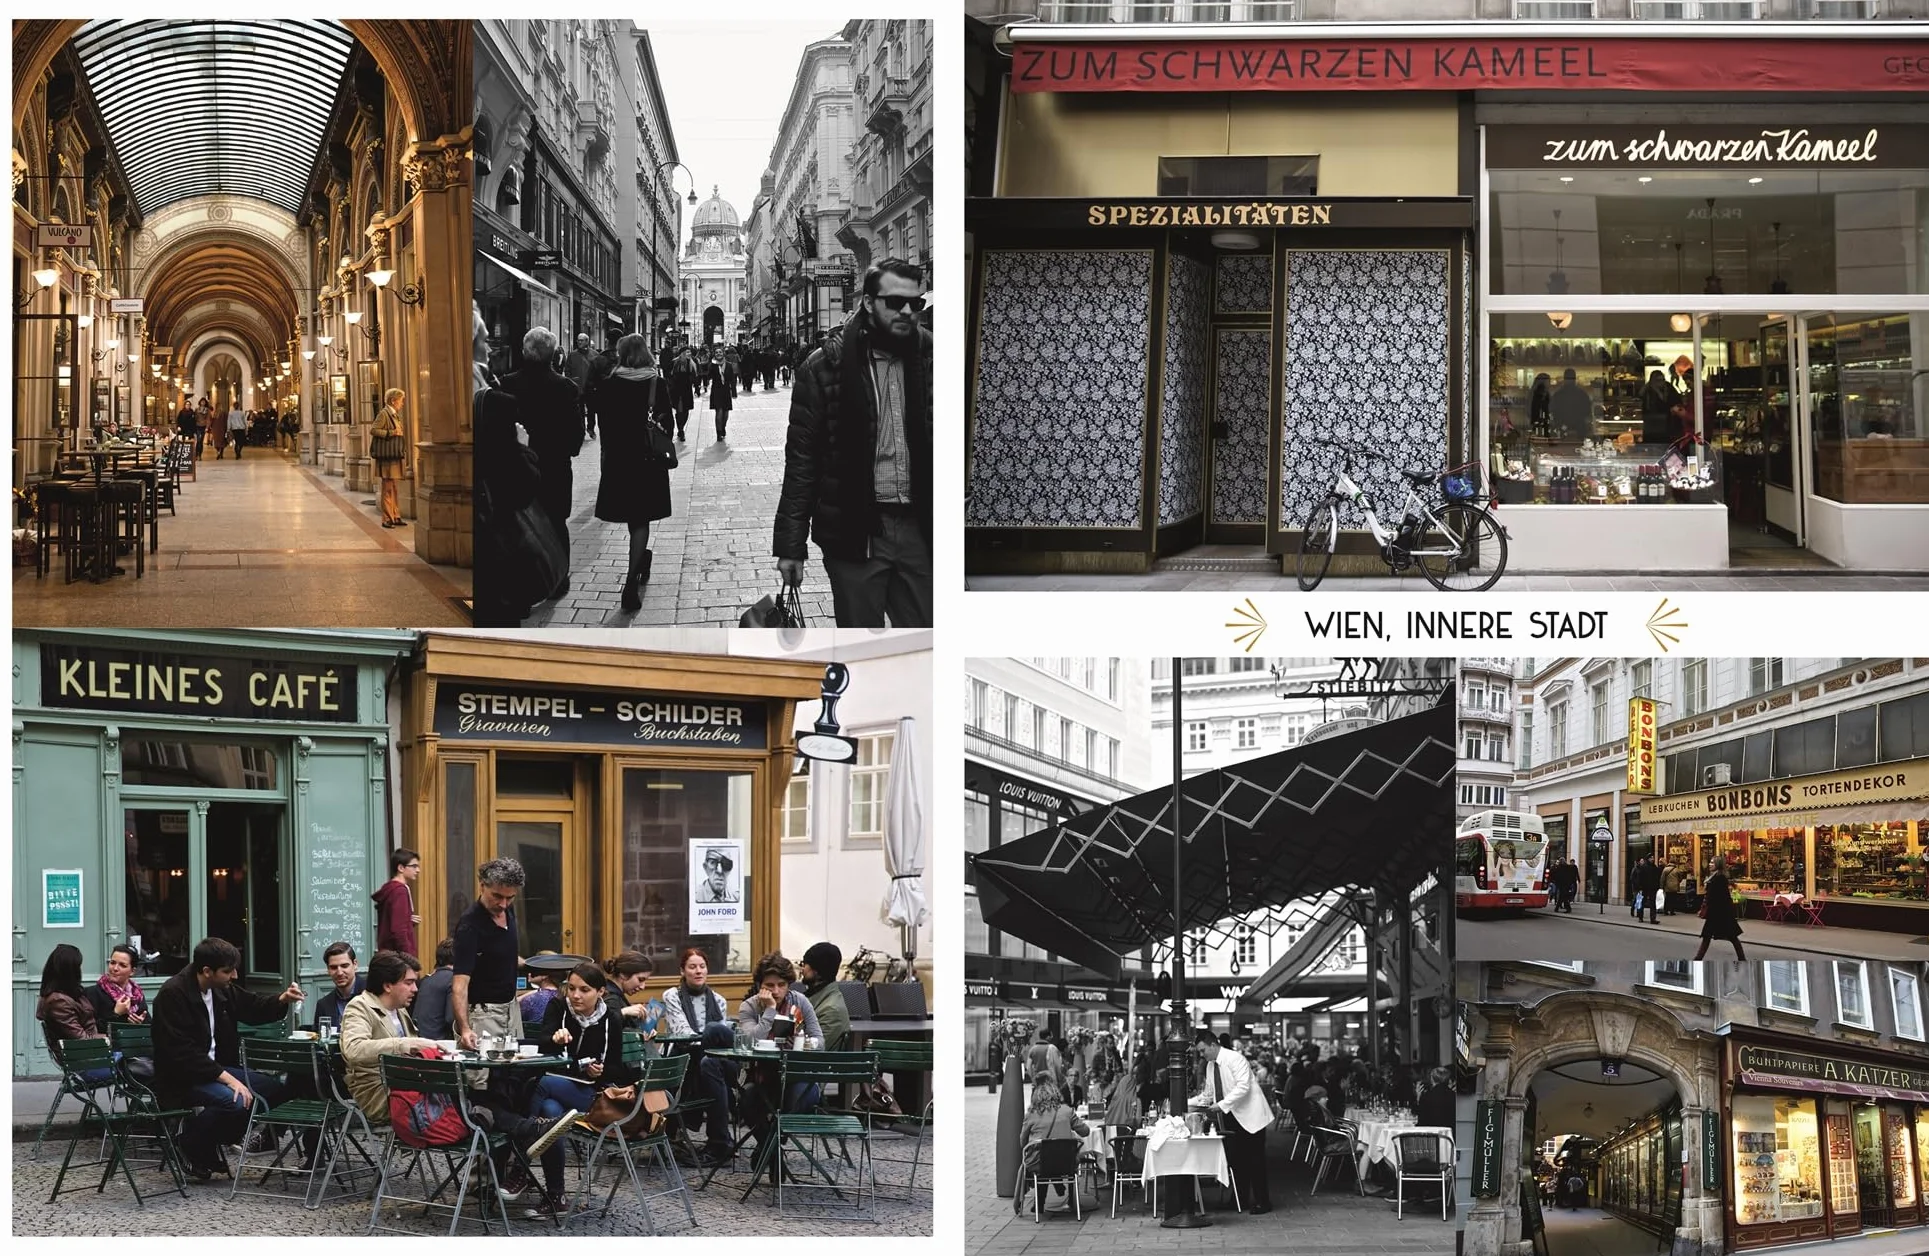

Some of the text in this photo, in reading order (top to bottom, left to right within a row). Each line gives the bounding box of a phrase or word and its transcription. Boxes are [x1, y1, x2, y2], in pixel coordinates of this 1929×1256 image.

[1020, 47, 1607, 81] ZUM SCHWARZEN KAMEEL
[1088, 202, 1332, 226] SPEZIALITÄTEN
[47, 226, 82, 237] VULCANO
[60, 659, 339, 711] KLEINES CAFÉ
[1317, 681, 1396, 693] STIEBITZ
[458, 692, 583, 719] STEMPEL
[616, 701, 743, 726] SCHILDER
[458, 714, 742, 744] Gravuren Buchstaben
[1641, 700, 1653, 790] BONBONS
[999, 781, 1062, 809] LOUIS VUITTON
[1648, 773, 1906, 814] LEBKUCHEN BONBONS TORTENDEKOR
[698, 908, 737, 916] JOHN FORD
[1607, 1065, 1615, 1074] 5
[1748, 1055, 1820, 1073] BUNTPAPIERE
[1748, 1073, 1772, 1083] Vienna
[1482, 1108, 1494, 1189] FIGLMÜLLER
